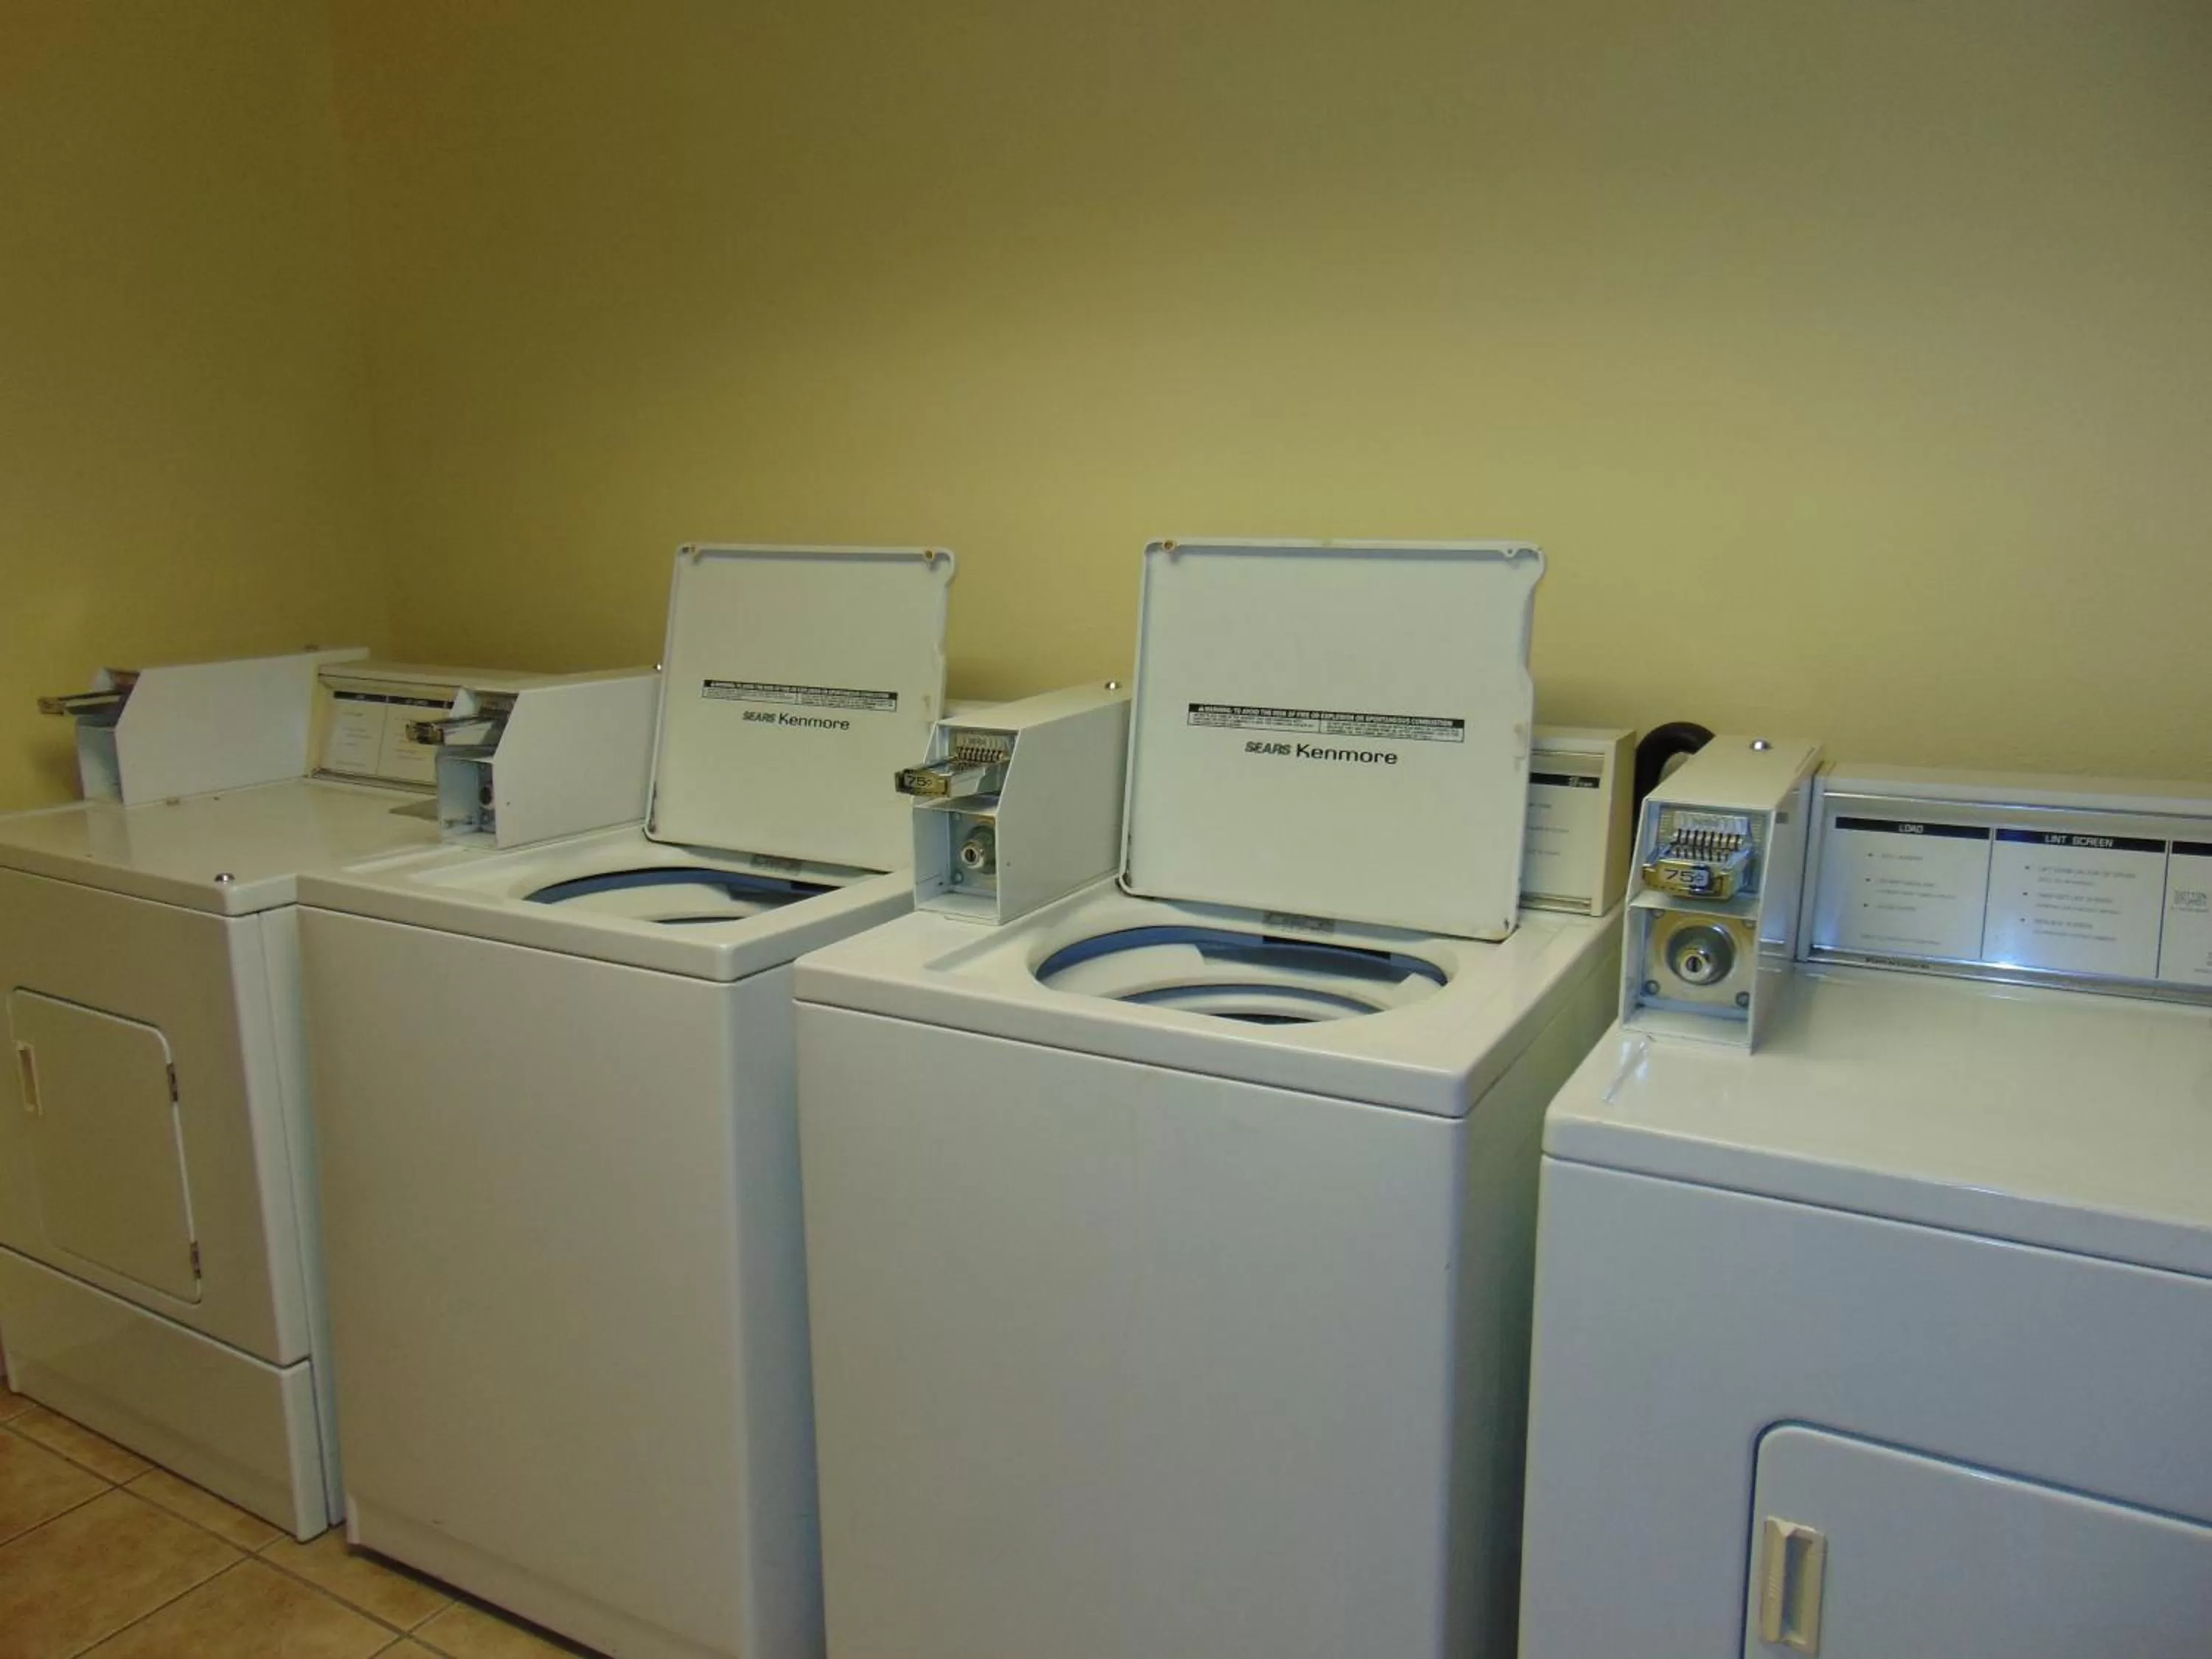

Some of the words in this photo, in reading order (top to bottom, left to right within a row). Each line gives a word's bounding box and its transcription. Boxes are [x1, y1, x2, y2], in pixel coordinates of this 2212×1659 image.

[742, 710, 776, 723] SEARS
[778, 713, 849, 731] Kenmore
[1245, 741, 1291, 756] SEARS
[1295, 743, 1398, 765] Kenmore
[2045, 834, 2067, 844] LINT
[2073, 835, 2114, 847] SCREEN
